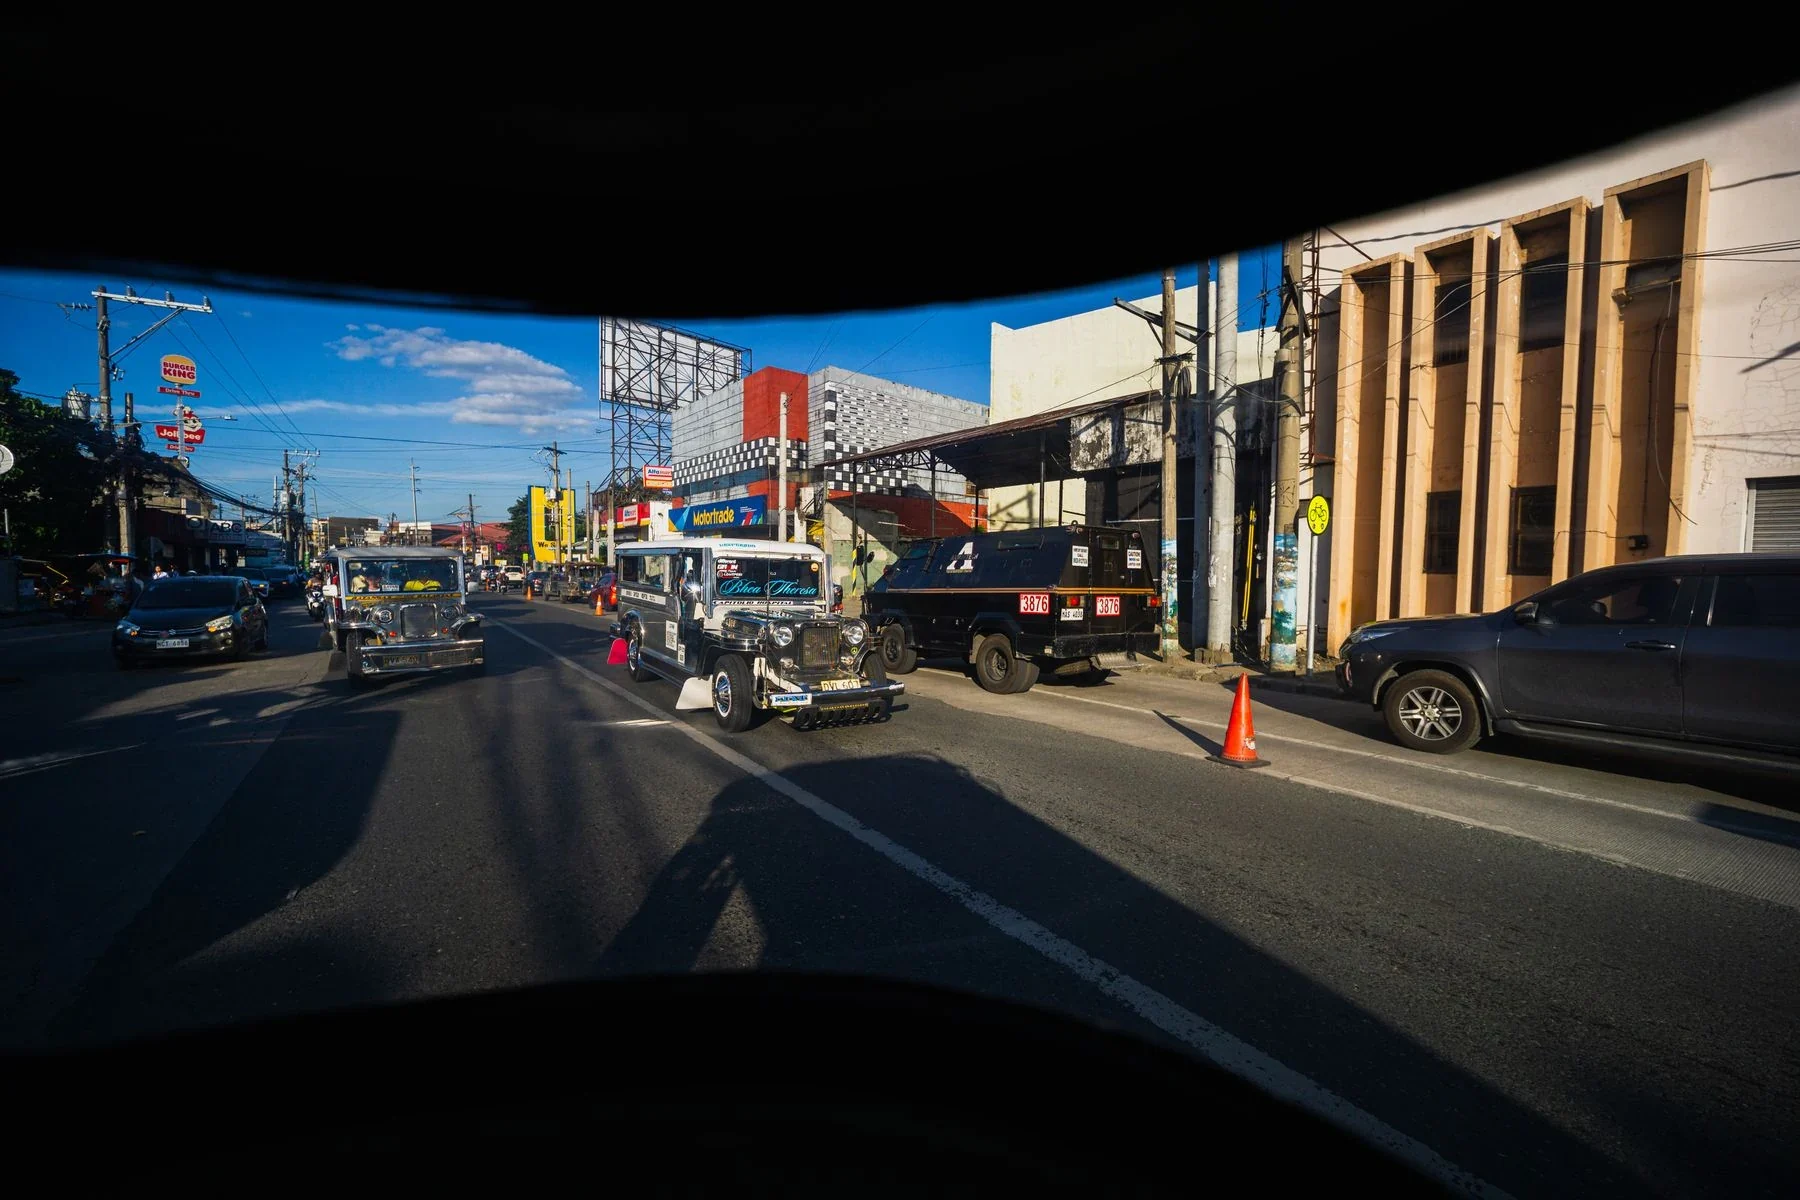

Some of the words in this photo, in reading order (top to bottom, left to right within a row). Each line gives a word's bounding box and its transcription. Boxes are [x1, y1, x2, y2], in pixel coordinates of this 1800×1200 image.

[163, 361, 195, 372] BURGER
[163, 367, 195, 380] KING
[693, 506, 734, 526] Motortrade
[764, 579, 817, 596] Theresa
[1023, 595, 1048, 612] 3876
[1099, 598, 1119, 614] 3876
